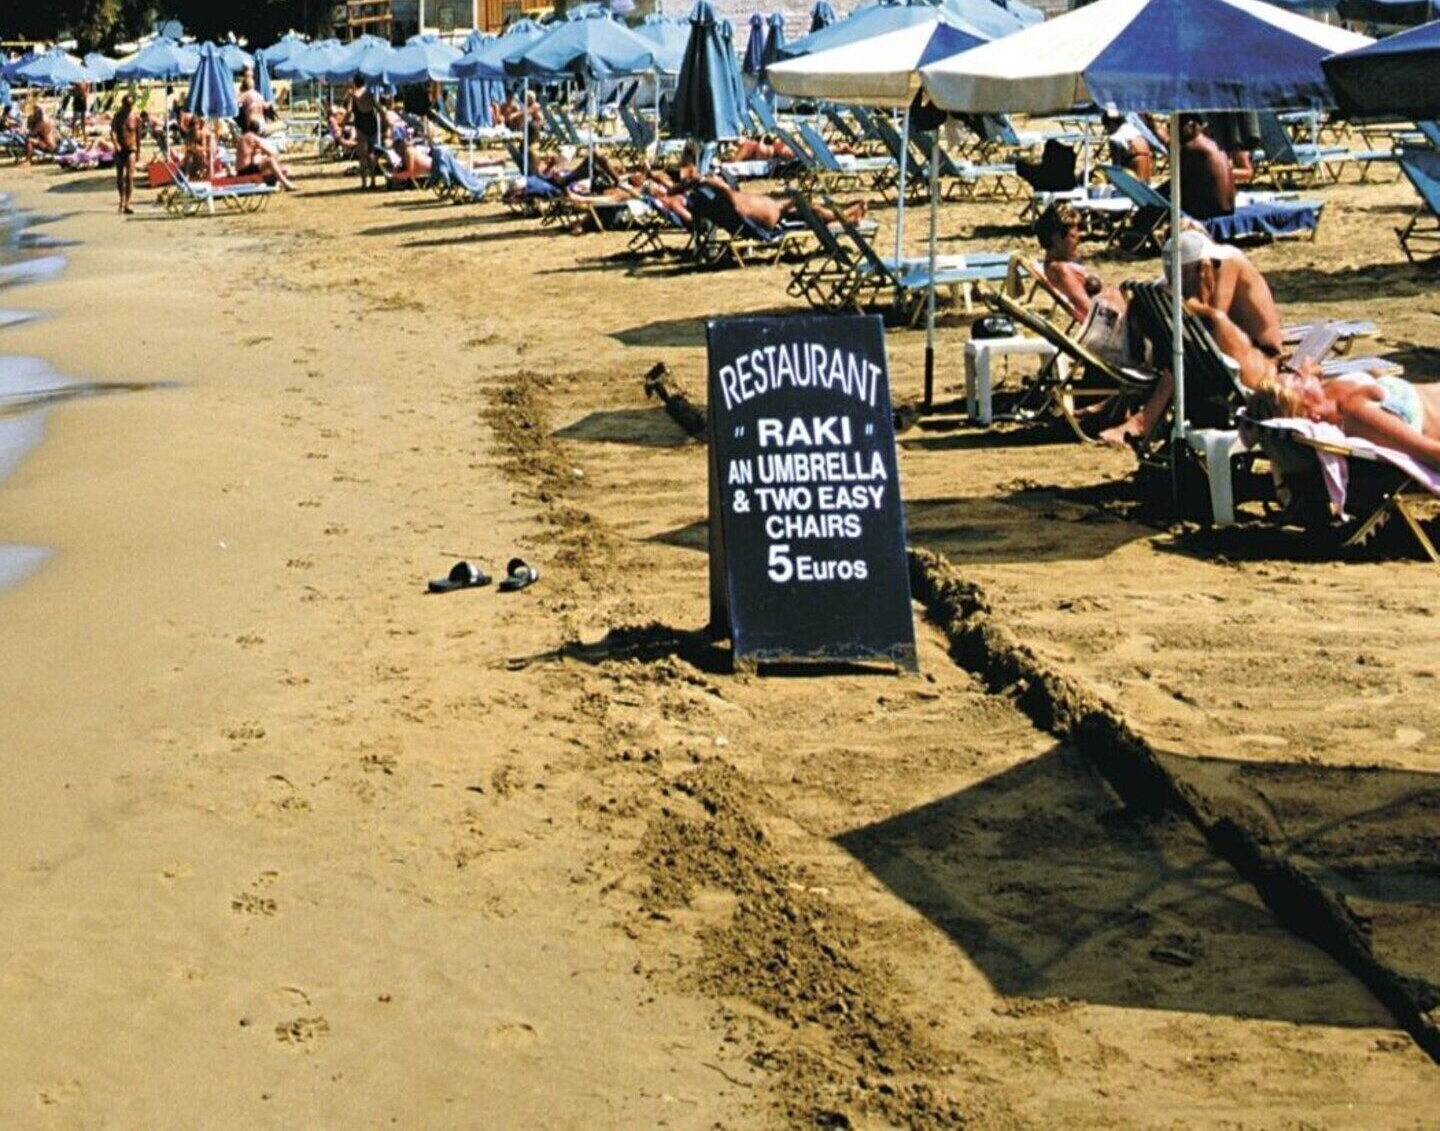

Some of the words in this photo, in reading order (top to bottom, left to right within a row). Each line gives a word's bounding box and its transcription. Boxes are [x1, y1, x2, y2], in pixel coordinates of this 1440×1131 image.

[719, 343, 882, 410] RESTAURANT
[728, 459, 753, 485] AN
[758, 451, 887, 483] UMBRELLA
[733, 489, 750, 513] &
[754, 487, 812, 511] TWO
[818, 485, 884, 509] EASY
[766, 514, 862, 539] CHAIRS
[768, 544, 793, 583] 5
[796, 556, 867, 580] Euros
